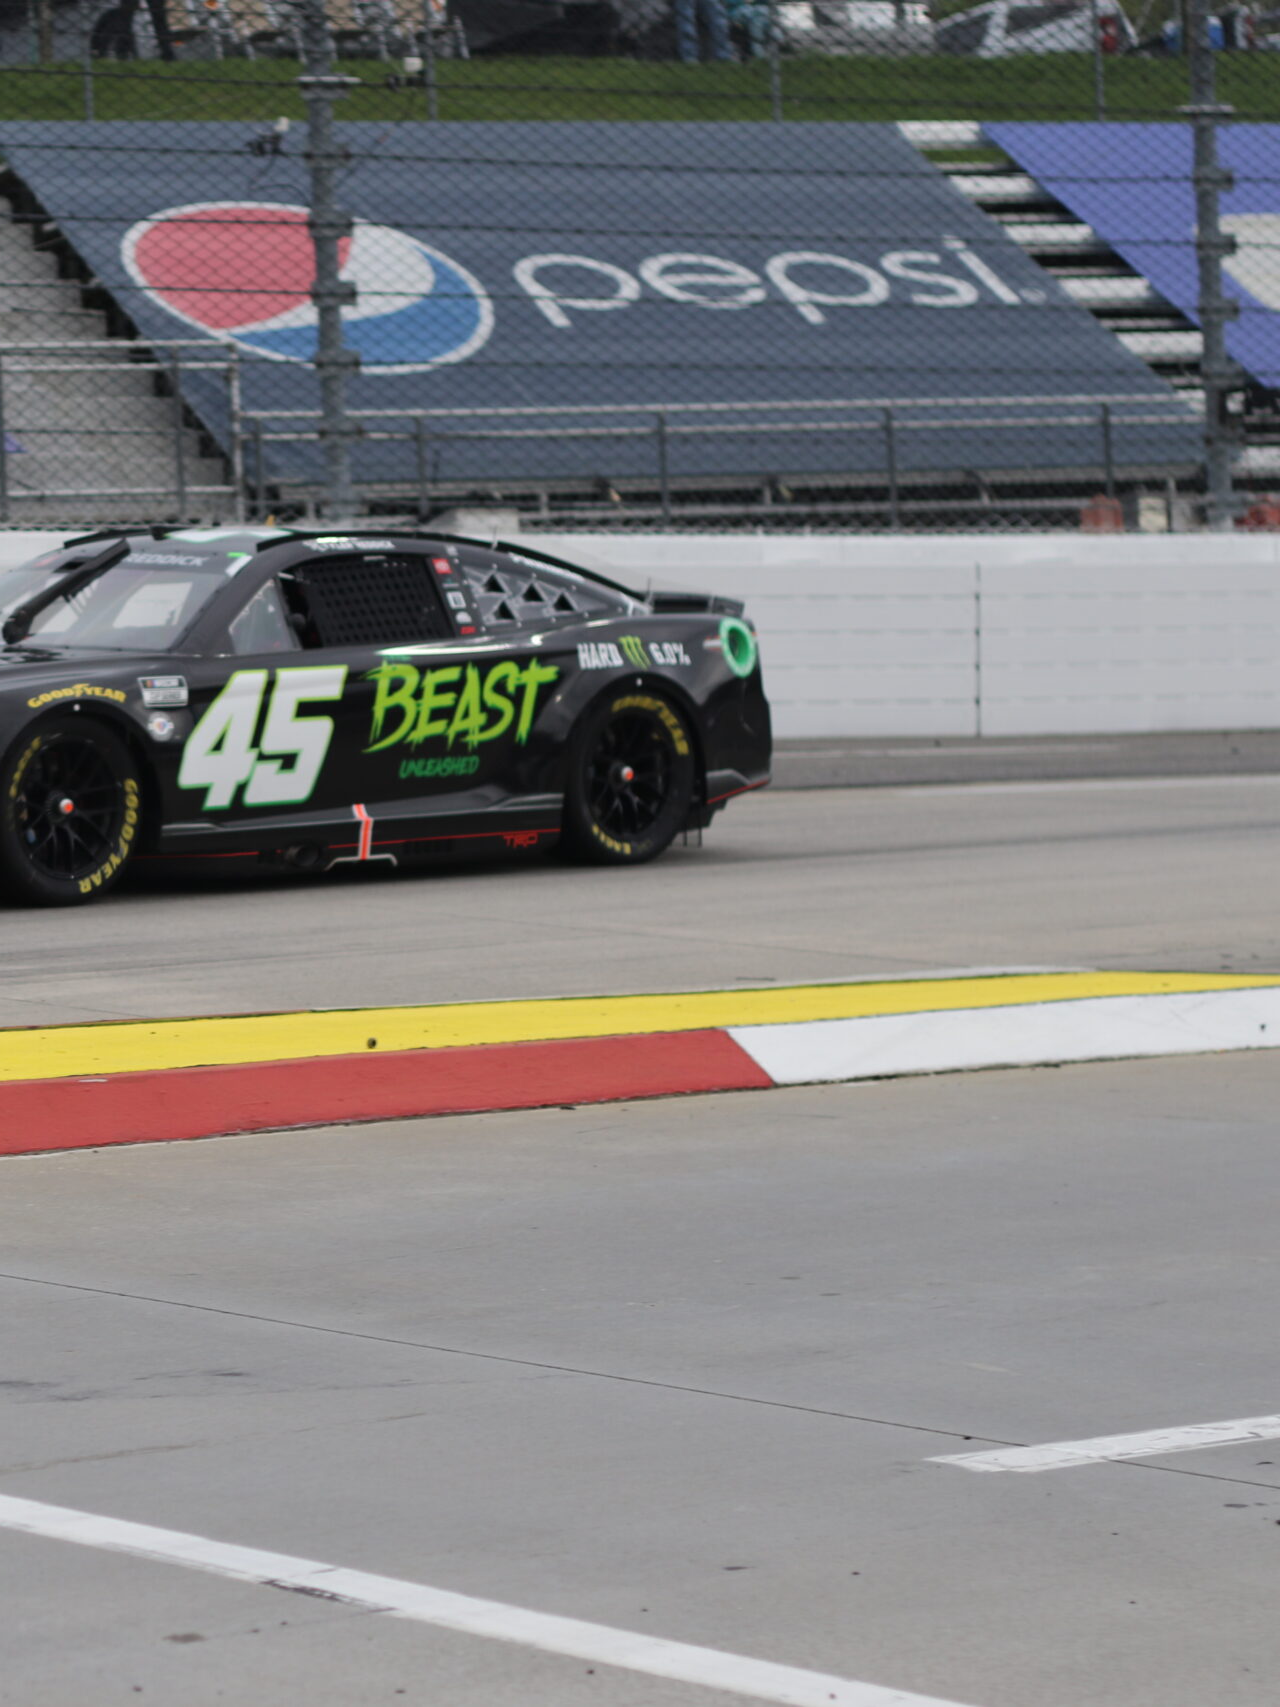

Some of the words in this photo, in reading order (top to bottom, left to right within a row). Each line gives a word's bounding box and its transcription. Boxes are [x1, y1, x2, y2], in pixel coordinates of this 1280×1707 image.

[513, 235, 1021, 327] pepsi
[27, 683, 127, 708] GOODYEAR
[577, 642, 624, 670] HARD
[178, 664, 348, 811] 45
[360, 657, 560, 752] BEAST
[398, 755, 480, 779] UNLEASHED
[78, 778, 139, 893] GOODYEAR
